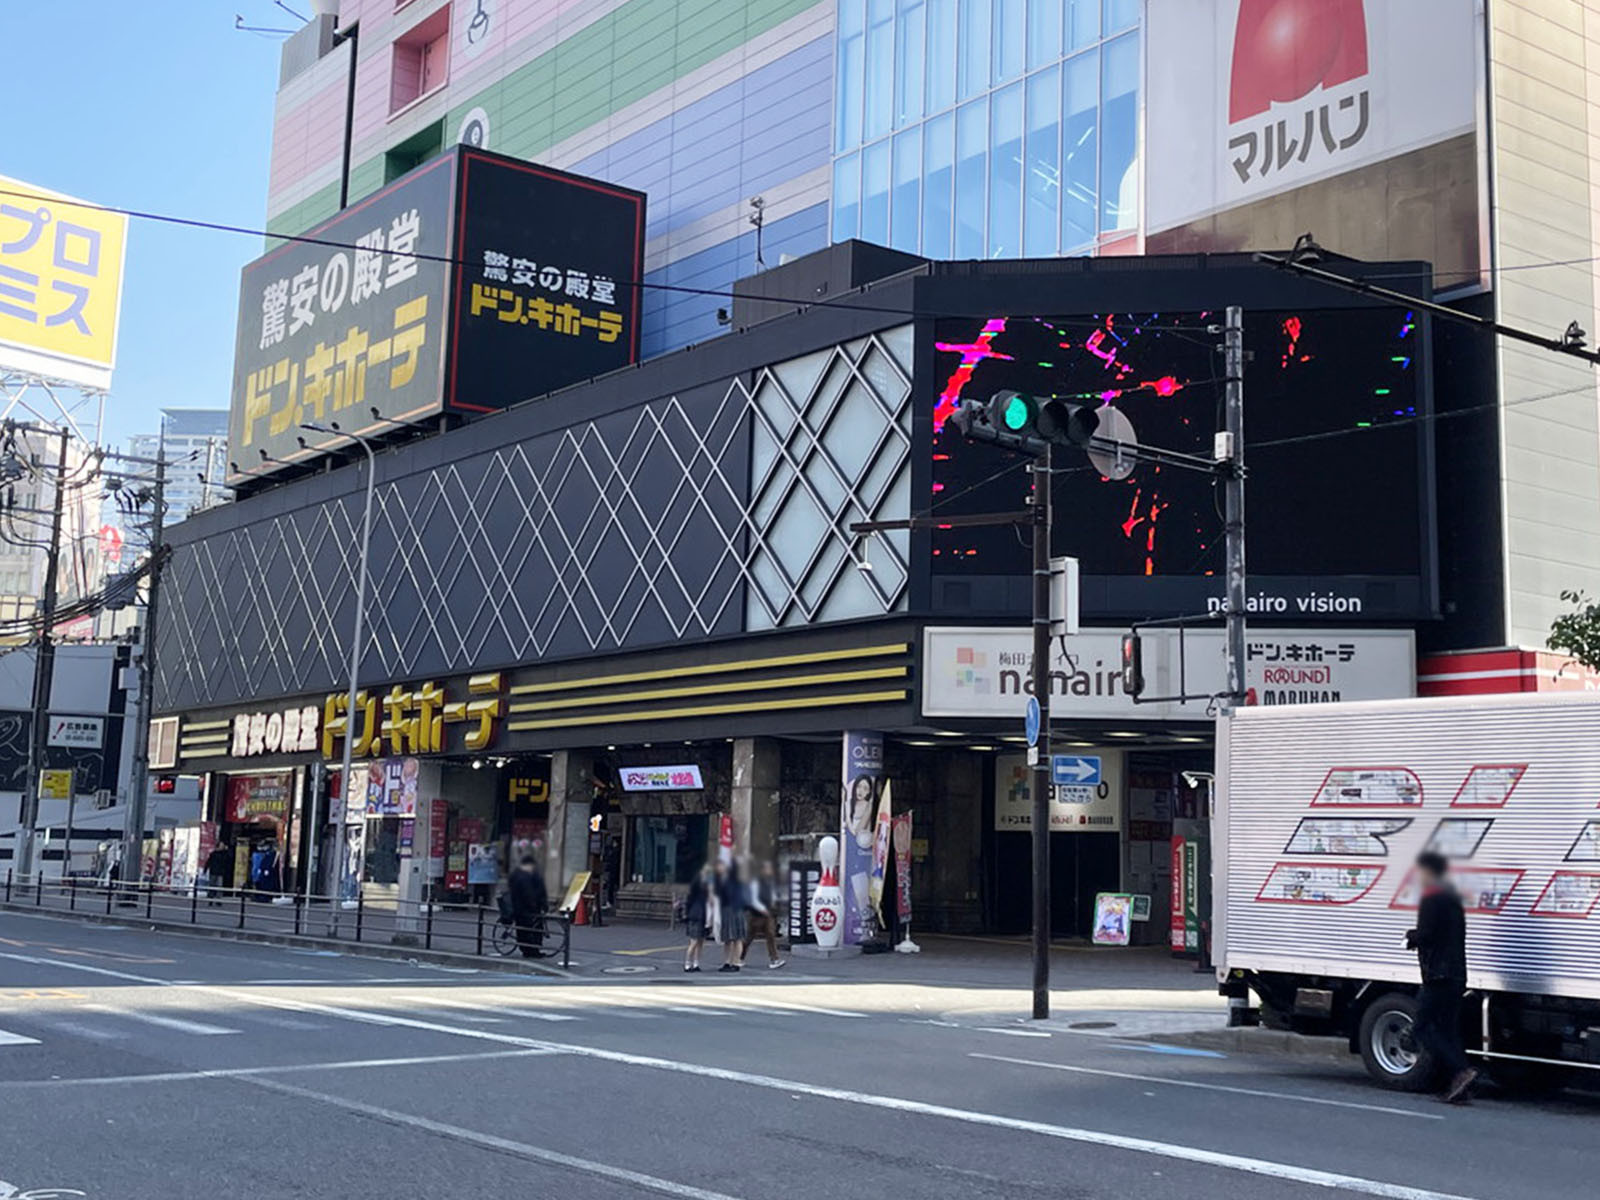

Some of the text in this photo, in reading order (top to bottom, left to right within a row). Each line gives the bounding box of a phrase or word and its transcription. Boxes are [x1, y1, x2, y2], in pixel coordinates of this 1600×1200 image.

[1228, 90, 1369, 184] マルハン
[0, 204, 102, 278] プロ
[0, 263, 94, 337] ミス
[260, 209, 420, 350] 驚安の殿堂
[482, 250, 616, 305] 驚安の殿堂
[1207, 592, 1361, 612] naairo vision
[999, 660, 1142, 697] nanair
[1264, 666, 1331, 685] ROUND1
